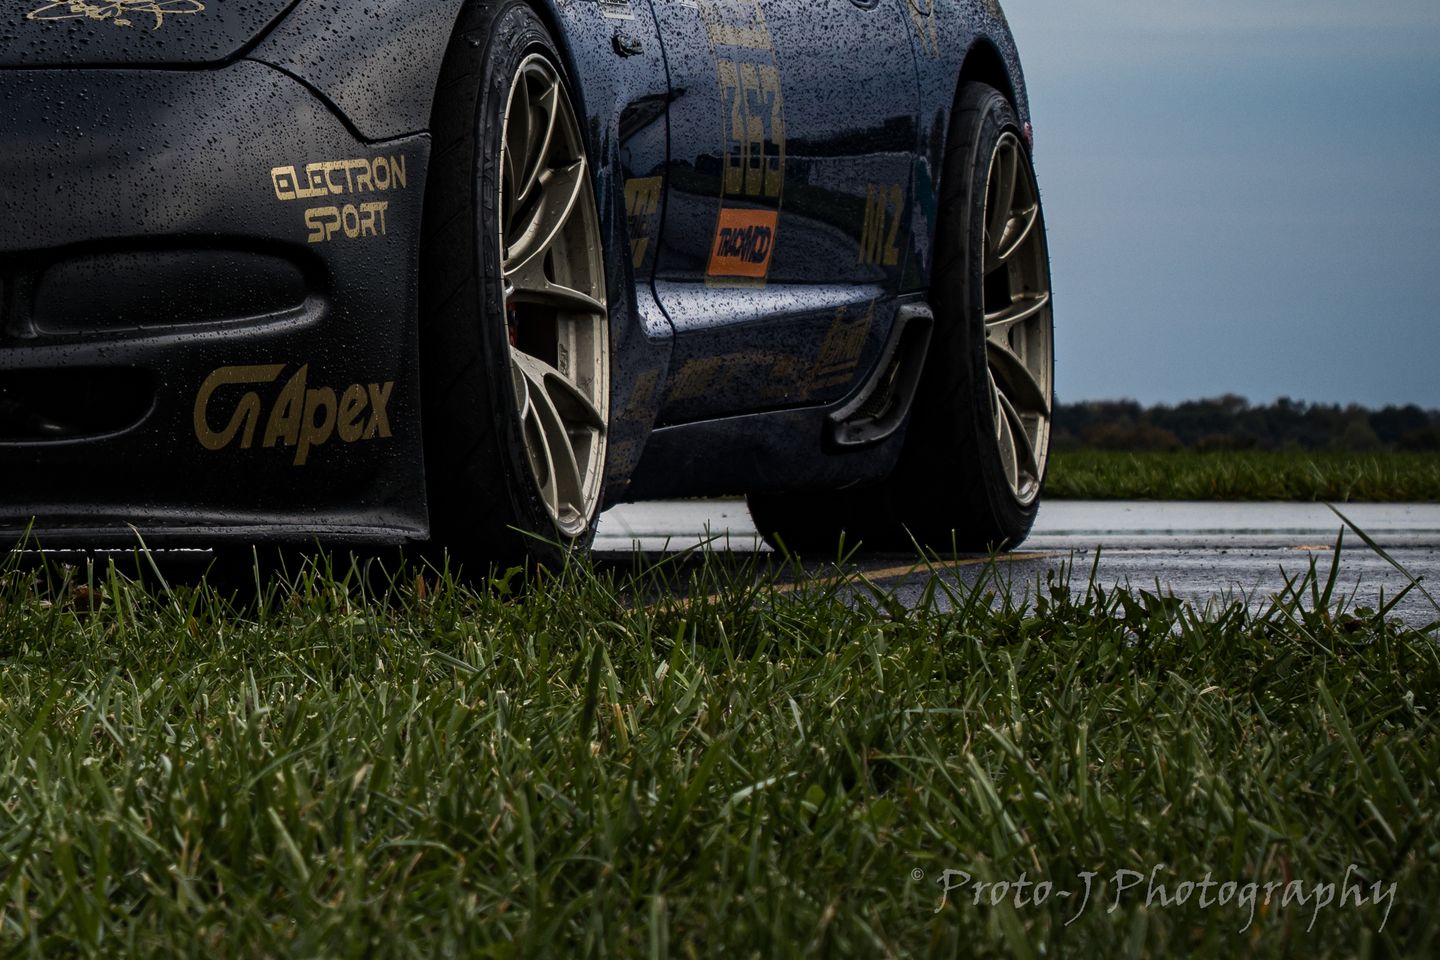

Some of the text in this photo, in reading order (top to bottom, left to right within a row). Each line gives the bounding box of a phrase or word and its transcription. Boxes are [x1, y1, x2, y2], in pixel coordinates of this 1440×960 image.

[270, 155, 407, 201] ELECTRON
[304, 200, 390, 243] SPORT
[263, 361, 396, 467] Apex
